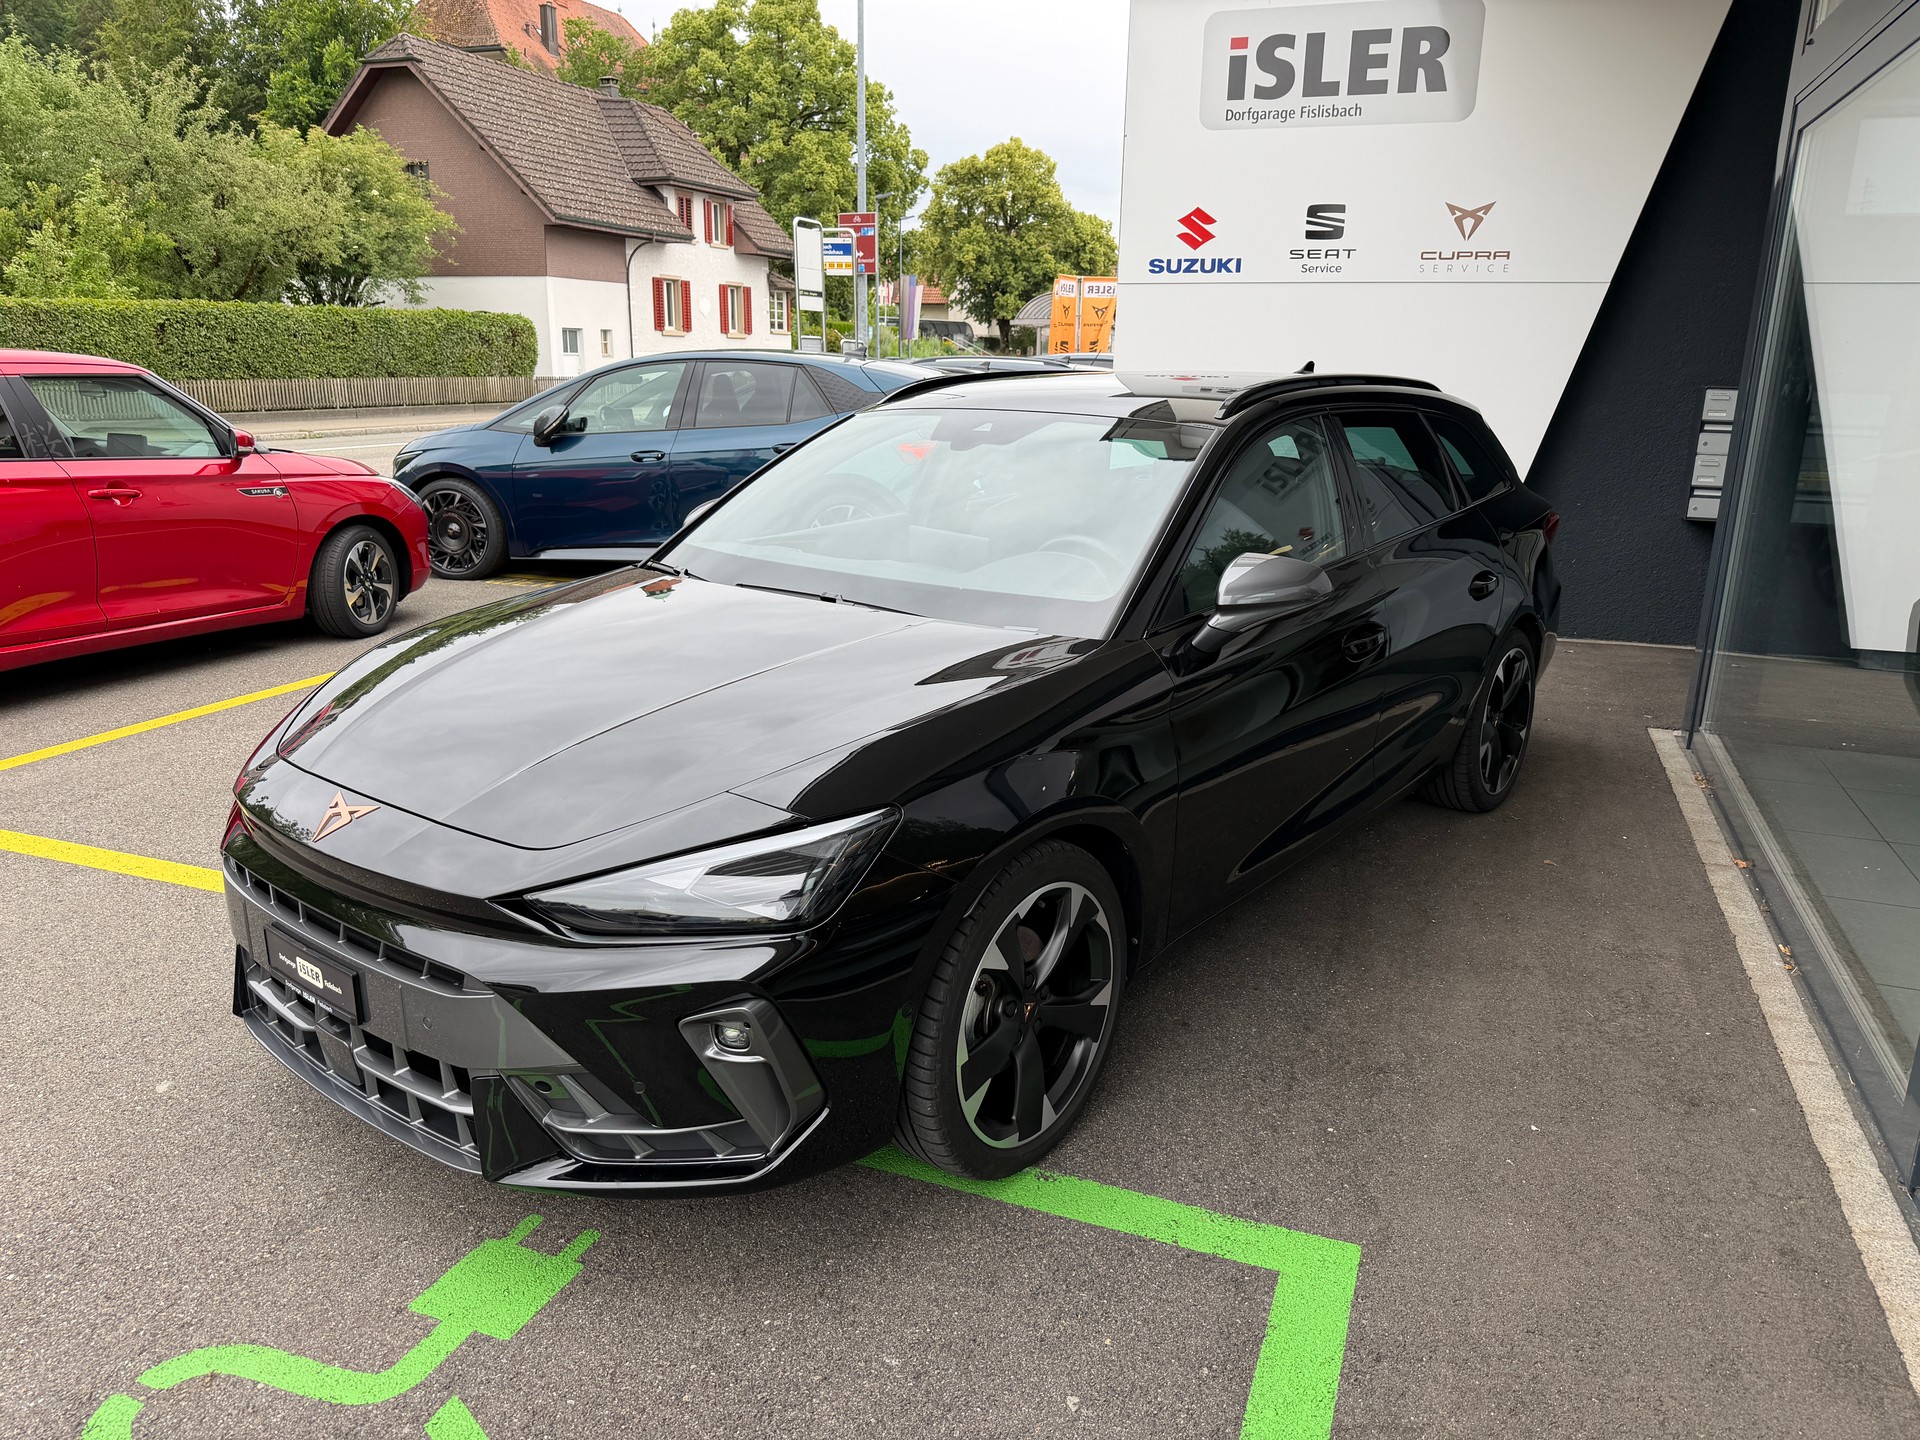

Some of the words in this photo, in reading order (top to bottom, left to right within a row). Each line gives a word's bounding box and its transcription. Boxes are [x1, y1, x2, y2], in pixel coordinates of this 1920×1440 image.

[1225, 106, 1296, 124] Dorfgarage
[1299, 103, 1363, 120] Fislisbach
[1289, 248, 1357, 260] SEAT
[1419, 250, 1511, 261] CUPRA
[1148, 257, 1242, 275] SUZUKI
[1300, 263, 1343, 274] Service
[1418, 263, 1510, 274] SERVICE
